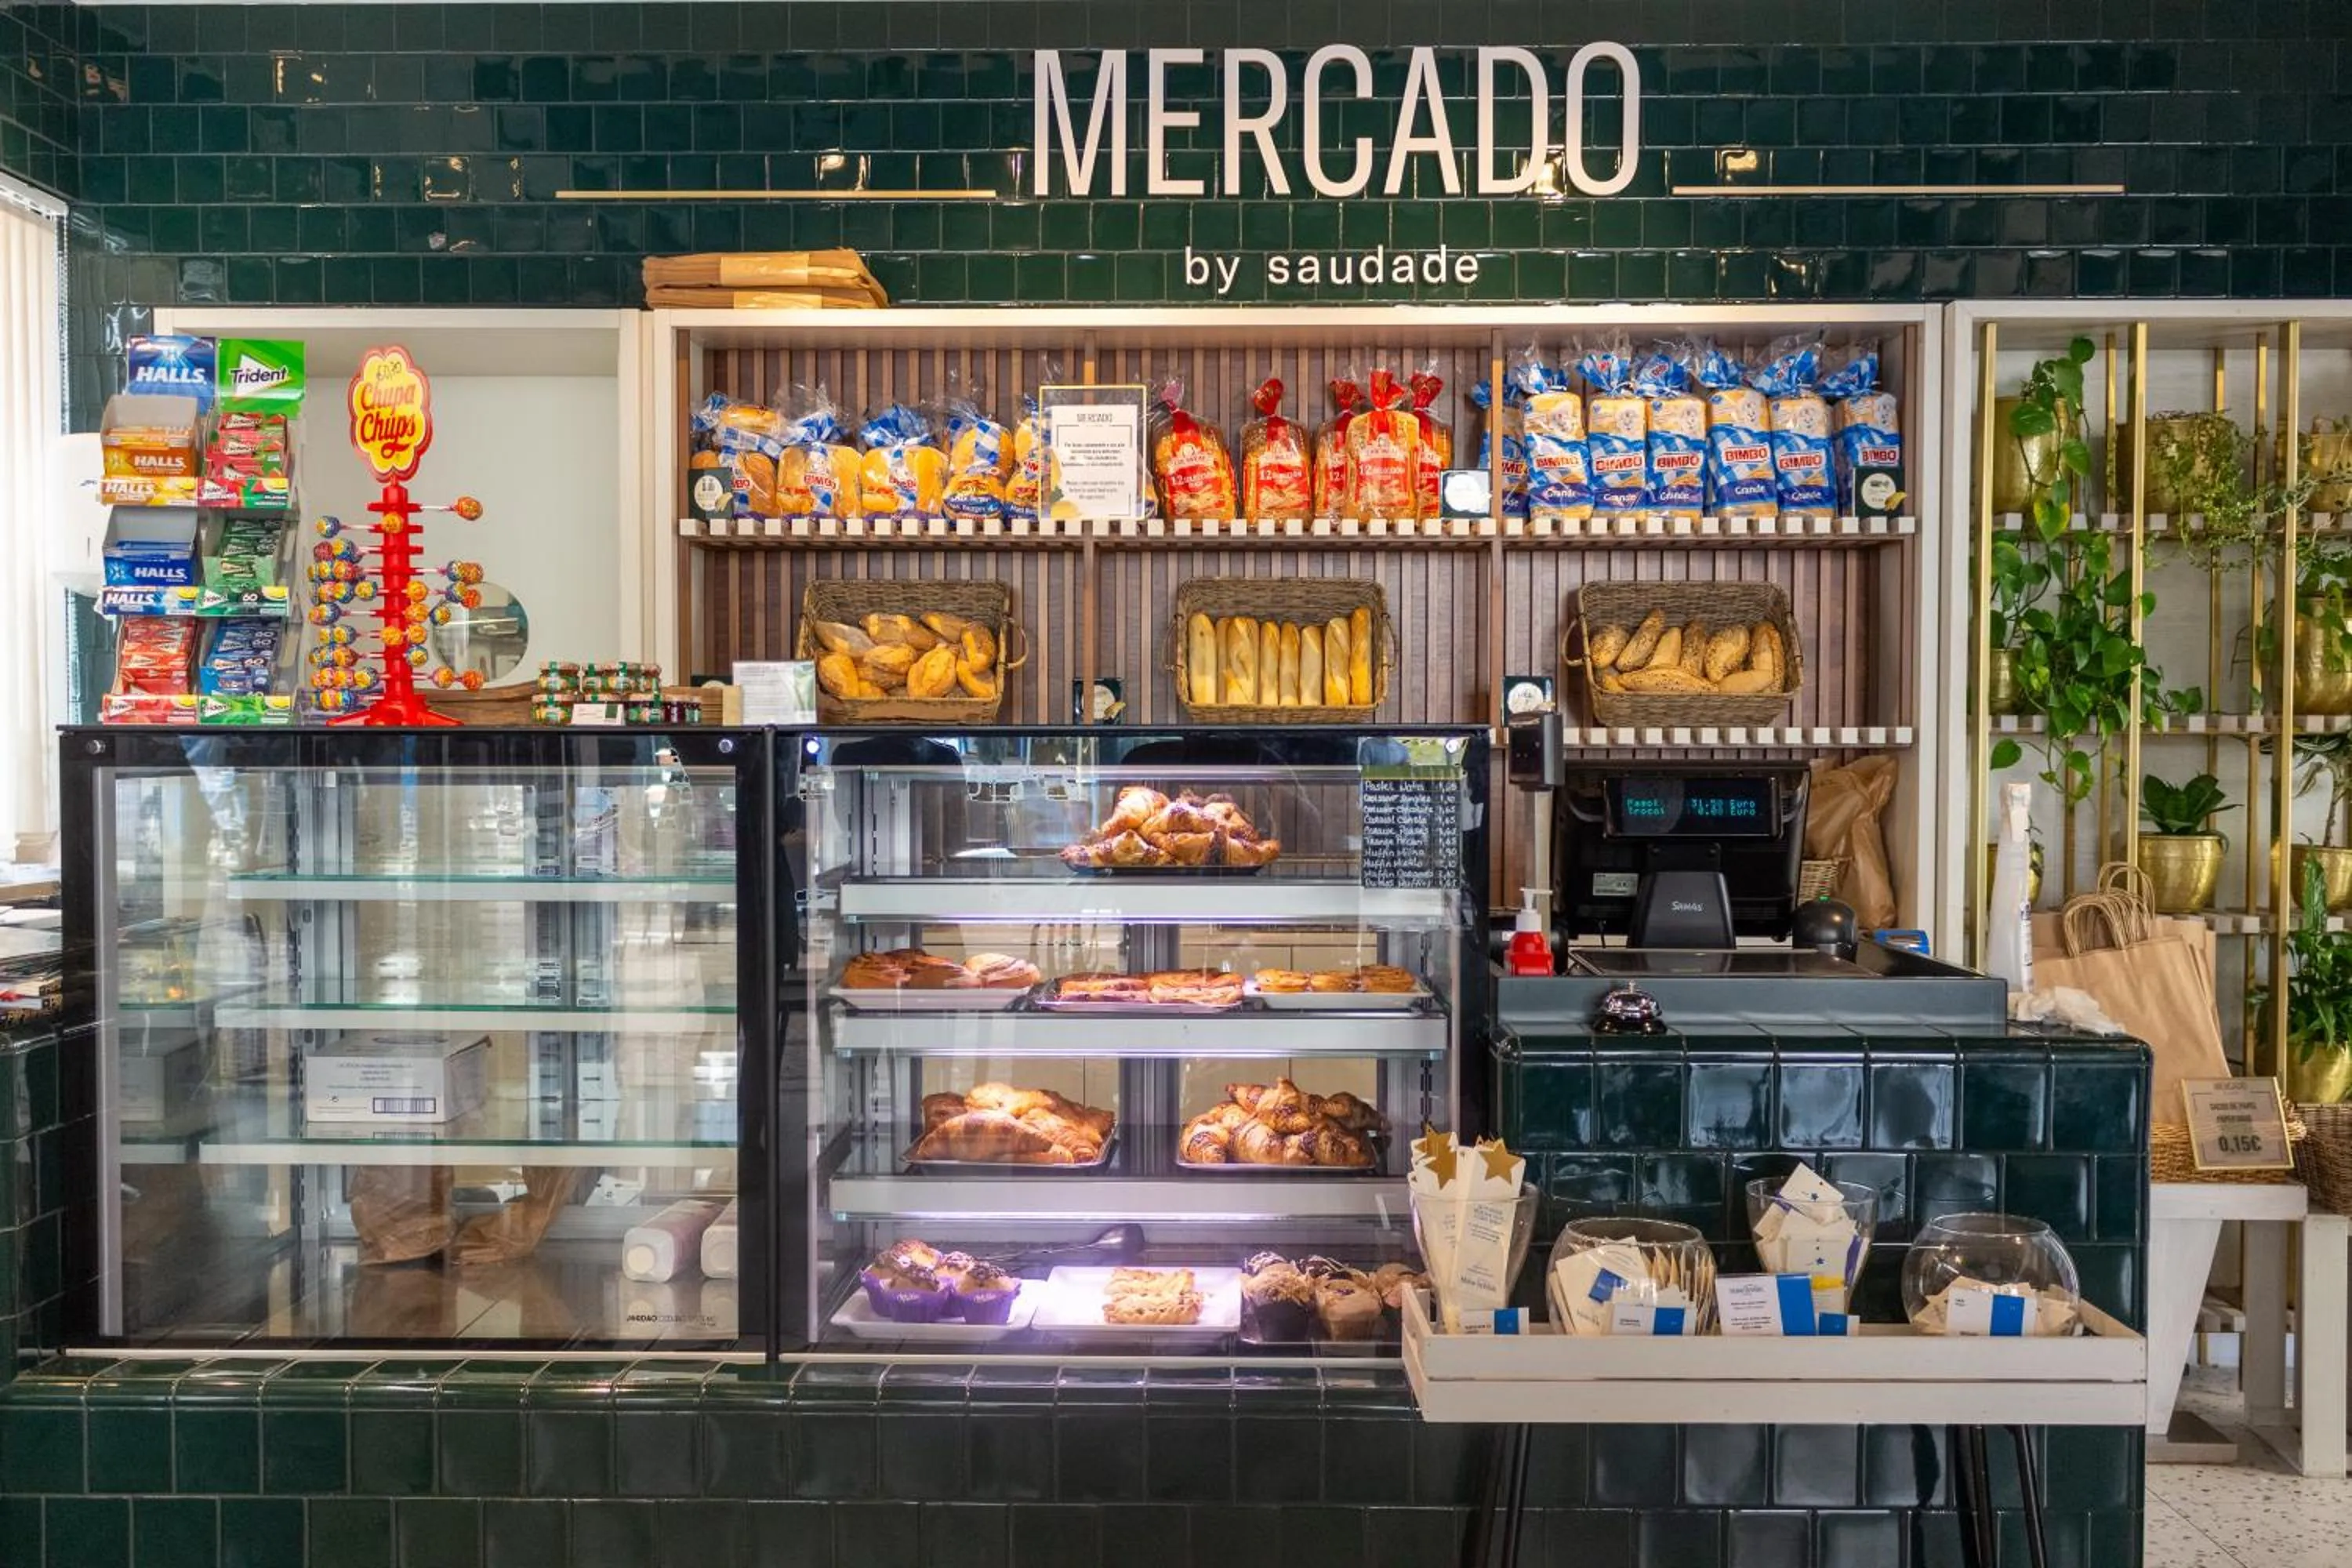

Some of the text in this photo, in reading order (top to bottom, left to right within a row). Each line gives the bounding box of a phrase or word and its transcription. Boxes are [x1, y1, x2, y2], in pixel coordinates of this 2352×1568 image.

[1033, 41, 1641, 198] MERCADO
[1185, 245, 1479, 293] by saudade
[136, 367, 205, 384] HALLS
[230, 365, 288, 383] Trident
[361, 383, 416, 412] Chupa
[361, 411, 416, 459] Chups
[1725, 448, 1767, 461] BIMBO
[1862, 450, 1896, 462] BIMBO
[134, 456, 187, 468] HALLS
[1535, 456, 1579, 468] BIMBO
[1595, 456, 1642, 470] BIMBO
[1657, 456, 1700, 468] BIMBO
[1779, 455, 1822, 469] BIMBO
[105, 481, 154, 494] HALLS
[1735, 484, 1765, 494] Grande
[1603, 492, 1637, 502] Grande
[134, 567, 187, 578] HALLS
[106, 593, 155, 605] HALLS
[243, 593, 258, 602] 60
[1730, 798, 1755, 808] Euro
[1730, 808, 1756, 816] Euro
